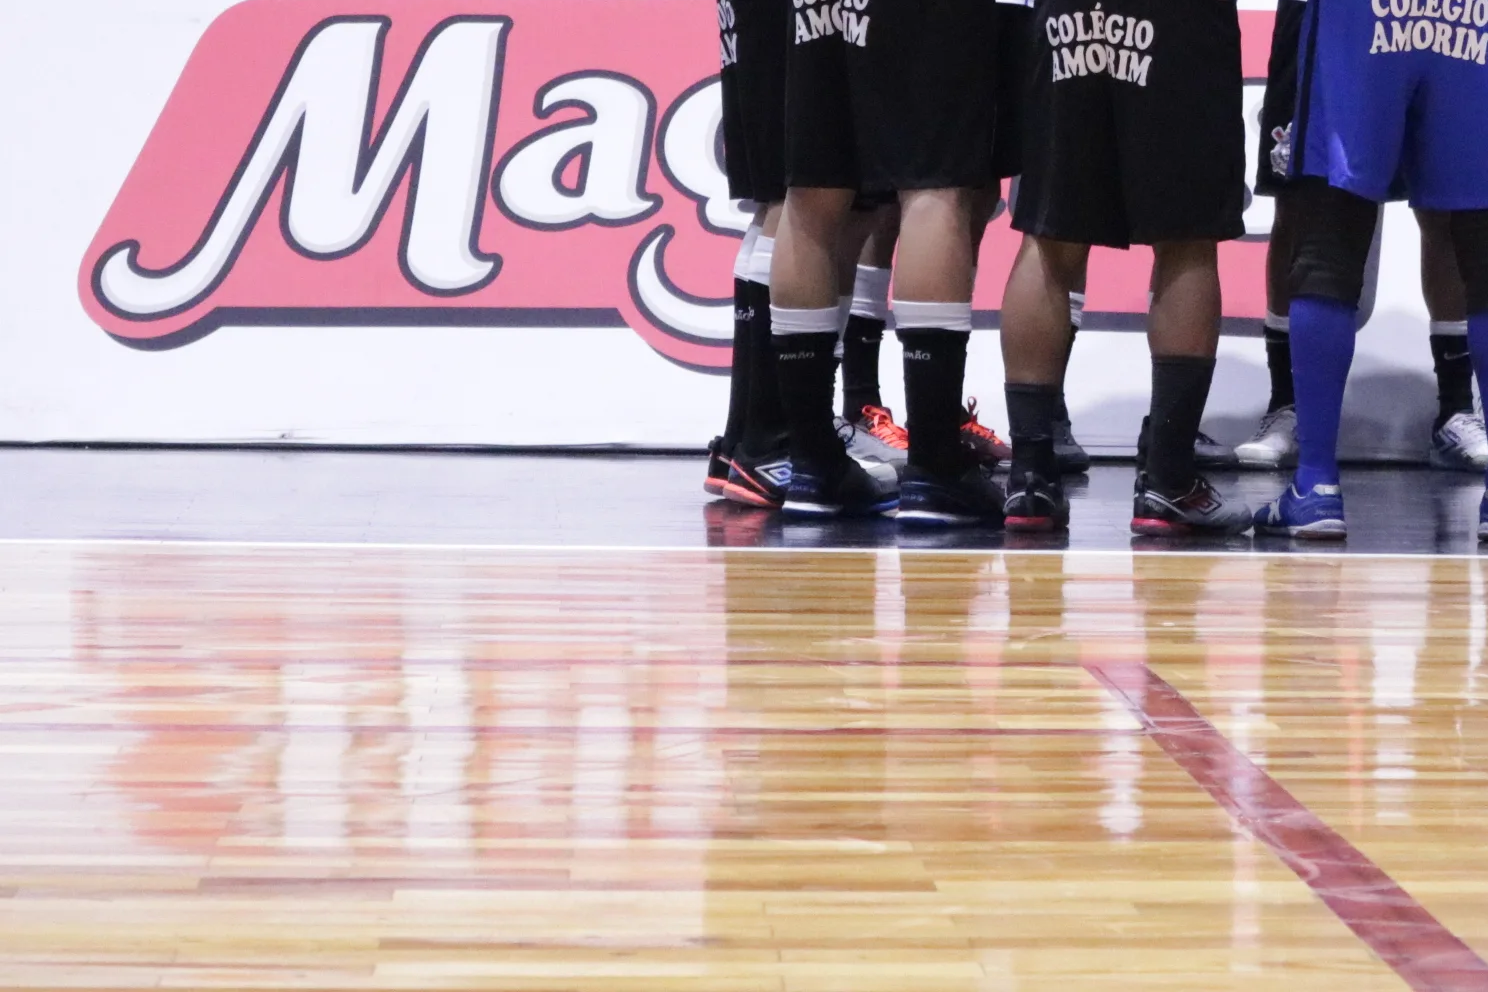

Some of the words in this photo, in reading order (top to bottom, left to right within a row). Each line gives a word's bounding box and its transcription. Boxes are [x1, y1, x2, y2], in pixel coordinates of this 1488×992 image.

[794, 1, 871, 48] AMOIM
[1045, 1, 1155, 51] COLÉGIO
[1052, 42, 1153, 87] AMORIM
